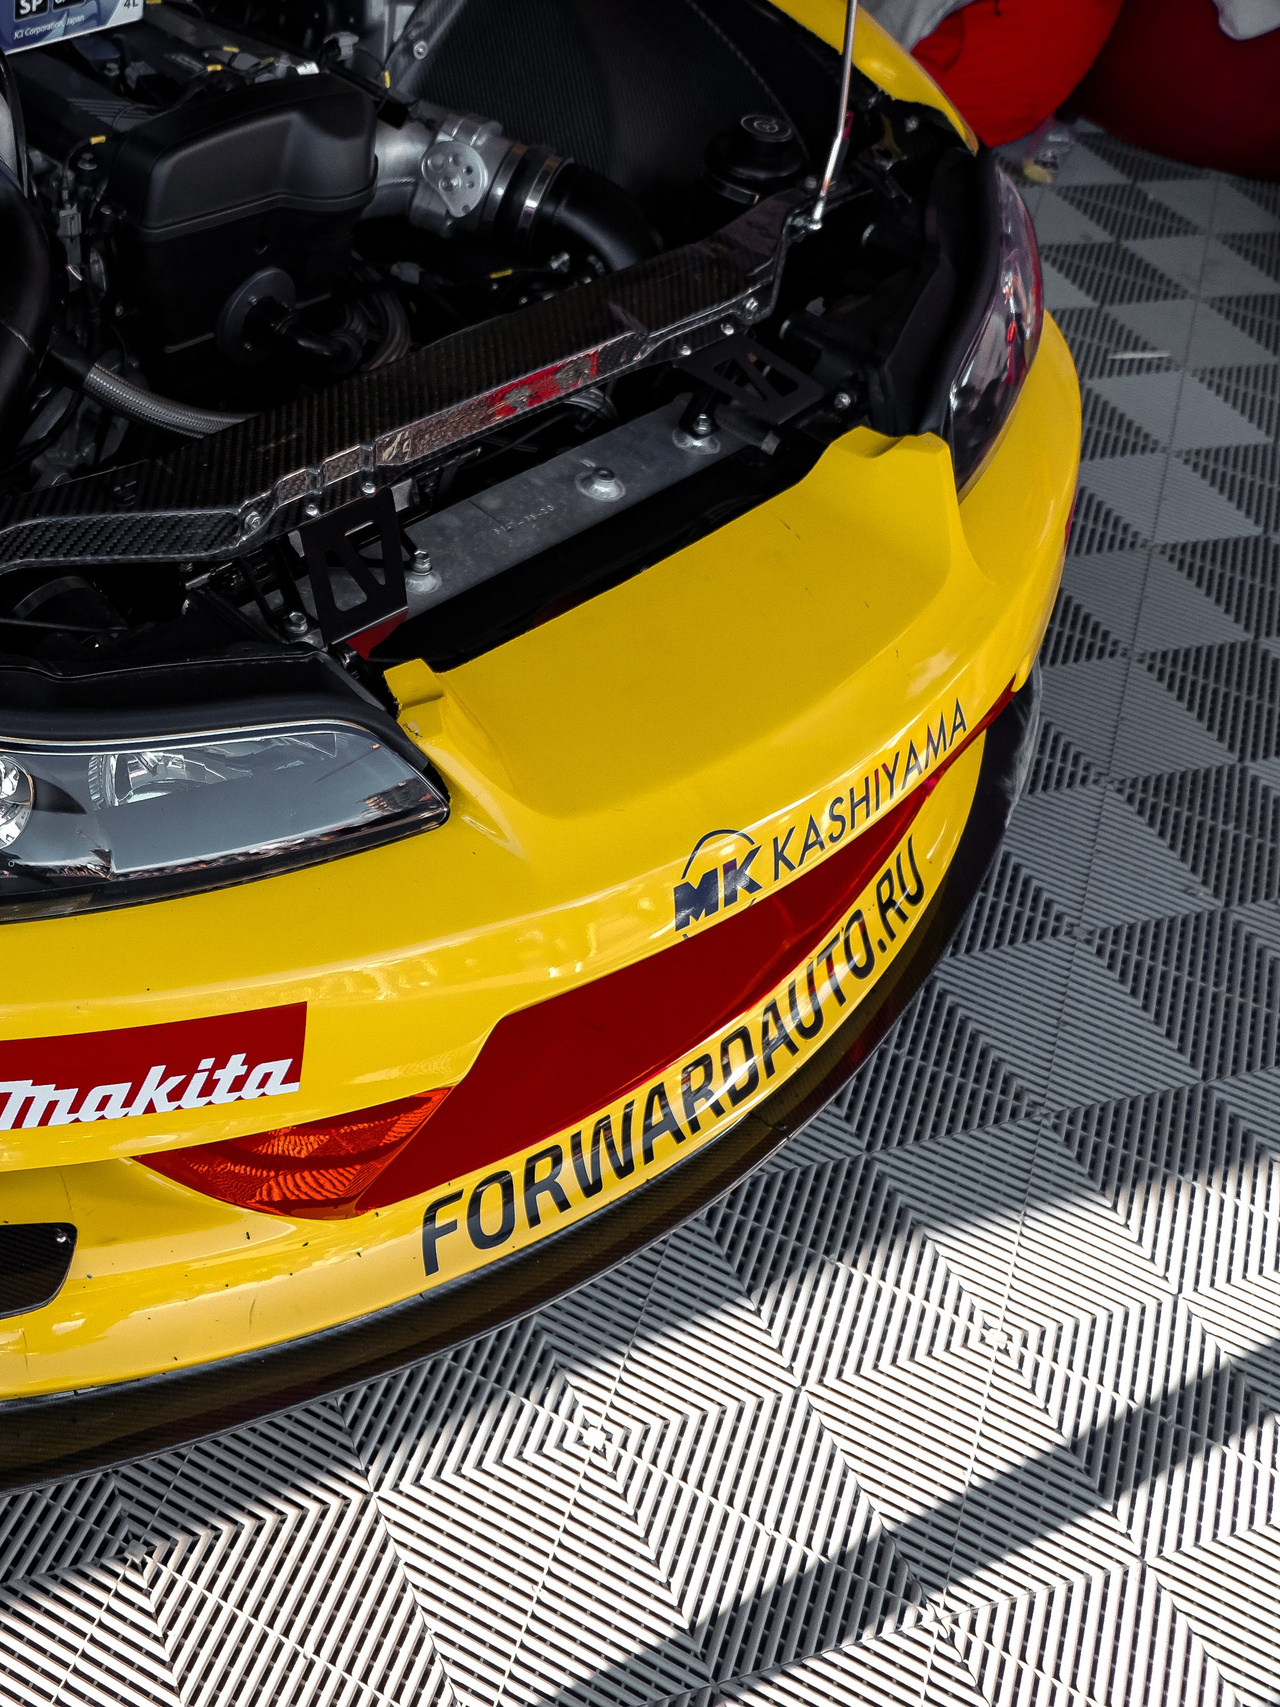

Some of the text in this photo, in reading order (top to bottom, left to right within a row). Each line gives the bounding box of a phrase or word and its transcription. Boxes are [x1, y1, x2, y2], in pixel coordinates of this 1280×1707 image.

[674, 697, 968, 932] MK KASHIYAMA
[421, 832, 925, 1277] FORWARDAUTO.RU
